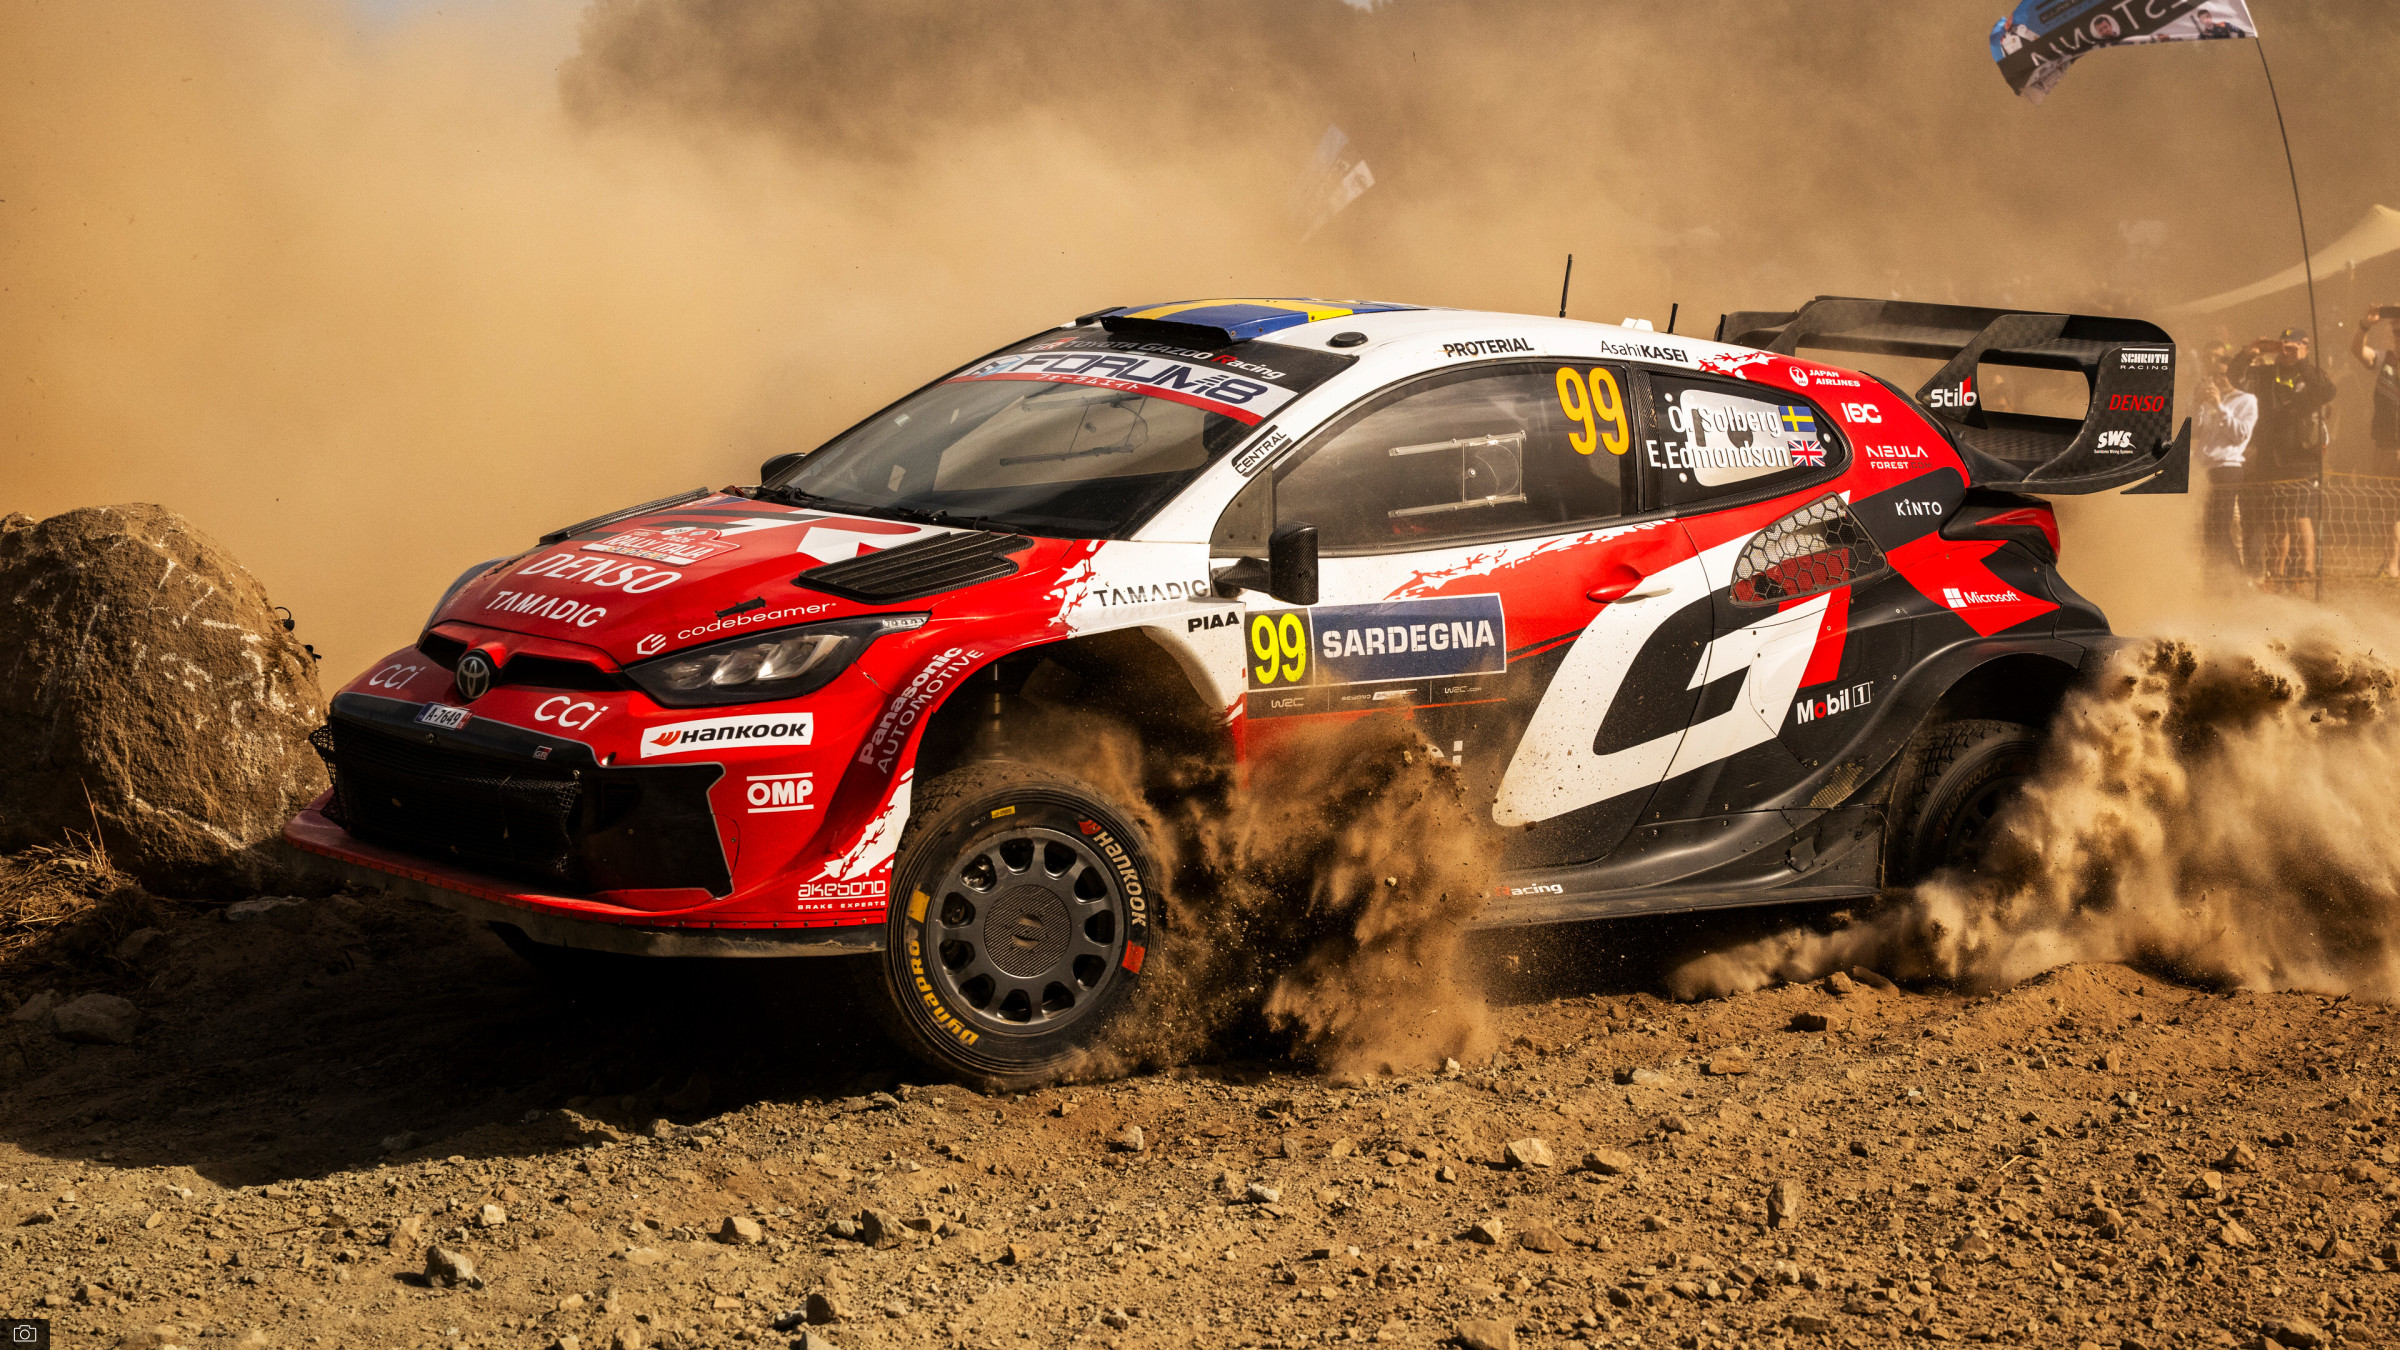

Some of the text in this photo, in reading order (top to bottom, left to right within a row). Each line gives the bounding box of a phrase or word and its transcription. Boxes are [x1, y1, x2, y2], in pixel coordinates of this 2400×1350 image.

[1065, 340, 1287, 380] TOYOTA GAZOO Racing
[1443, 338, 1534, 358] PROTERIAL
[1601, 340, 1688, 363] AsahiKASEI
[2121, 353, 2168, 364] SCHROTH
[1009, 353, 1270, 405] FORUM8
[1809, 369, 1840, 378] JAPAN
[1816, 378, 1861, 388] AIRLINES
[1930, 379, 1978, 408] Stilo
[2108, 394, 2165, 412] DENSO
[1556, 366, 1630, 456] 99
[1698, 405, 1782, 439] Solberg
[1233, 430, 1289, 476] CENTRAL
[2096, 430, 2137, 449] SWS
[603, 534, 663, 550] RALLY
[650, 541, 715, 559] ITALIA
[517, 552, 683, 594] DENSO
[1093, 579, 1209, 607] TAMADIC
[1963, 590, 2021, 606] Microsoft
[485, 590, 607, 628] TAMADIC
[677, 602, 831, 641] codebeamer
[1187, 611, 1240, 633] PIAA
[1251, 612, 1307, 685] 99
[1322, 619, 1496, 659] SARDEGNA
[425, 707, 462, 726] A-7649
[858, 646, 963, 766] Panasonic
[877, 649, 985, 774] AUTOMOTIVE
[1271, 697, 1305, 709] WRC
[1796, 688, 1850, 725] Mobil
[747, 779, 814, 807] OMP
[798, 879, 886, 897] akebono
[840, 900, 886, 908] EXPERTS
